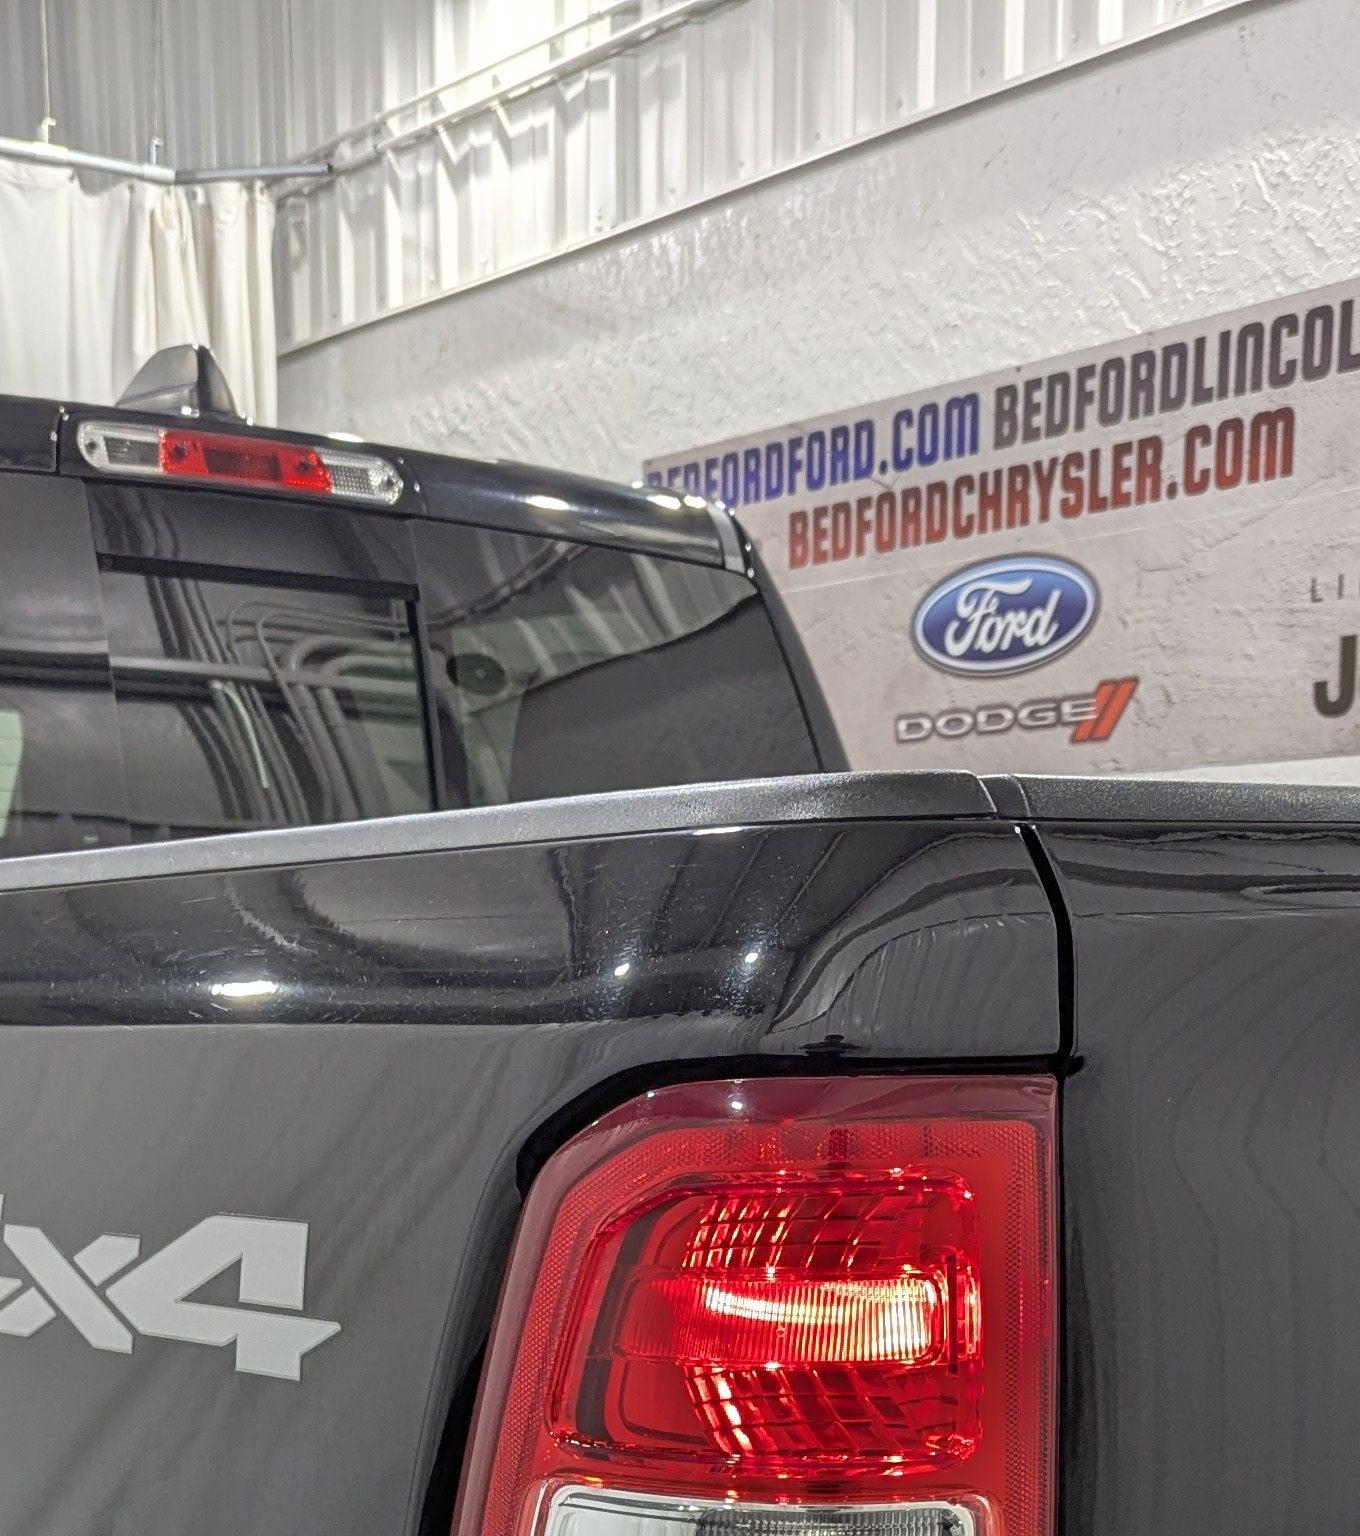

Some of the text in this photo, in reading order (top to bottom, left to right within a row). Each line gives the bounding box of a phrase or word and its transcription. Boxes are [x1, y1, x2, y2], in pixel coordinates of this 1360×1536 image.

[788, 406, 1296, 570] BEDFORDCHRYSLER.COM
[943, 576, 1063, 658] Ford
[895, 694, 1098, 744] DODGE
